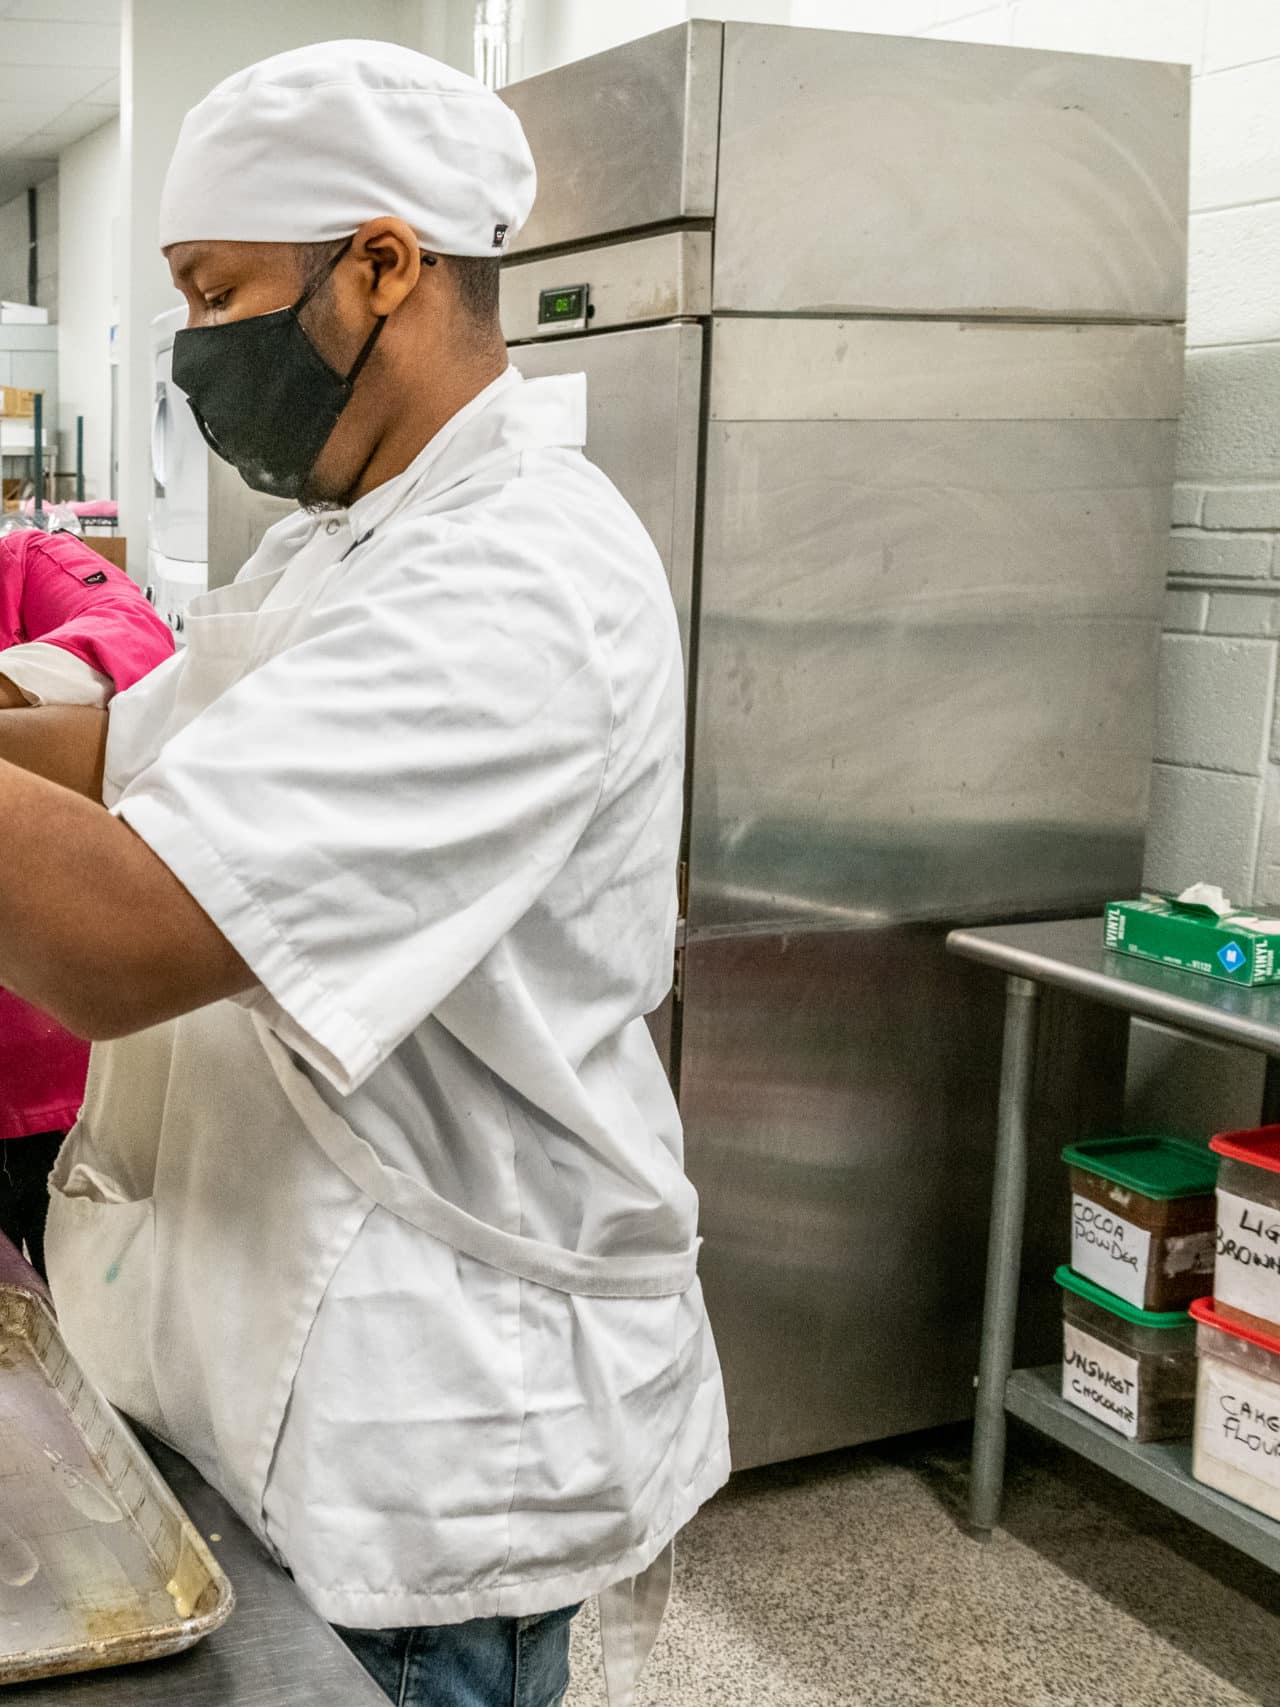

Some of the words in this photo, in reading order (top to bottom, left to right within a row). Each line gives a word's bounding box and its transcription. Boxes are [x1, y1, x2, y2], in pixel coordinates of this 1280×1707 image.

[1106, 909, 1120, 940] VINYL
[1253, 939, 1268, 977] VINYL
[1073, 1202, 1124, 1241] COCOA
[1074, 1220, 1138, 1272] POWDER
[1064, 1350, 1135, 1396] UNSWEET
[1072, 1379, 1135, 1423] CHOCOLATE
[1220, 1395, 1280, 1433] CAKE
